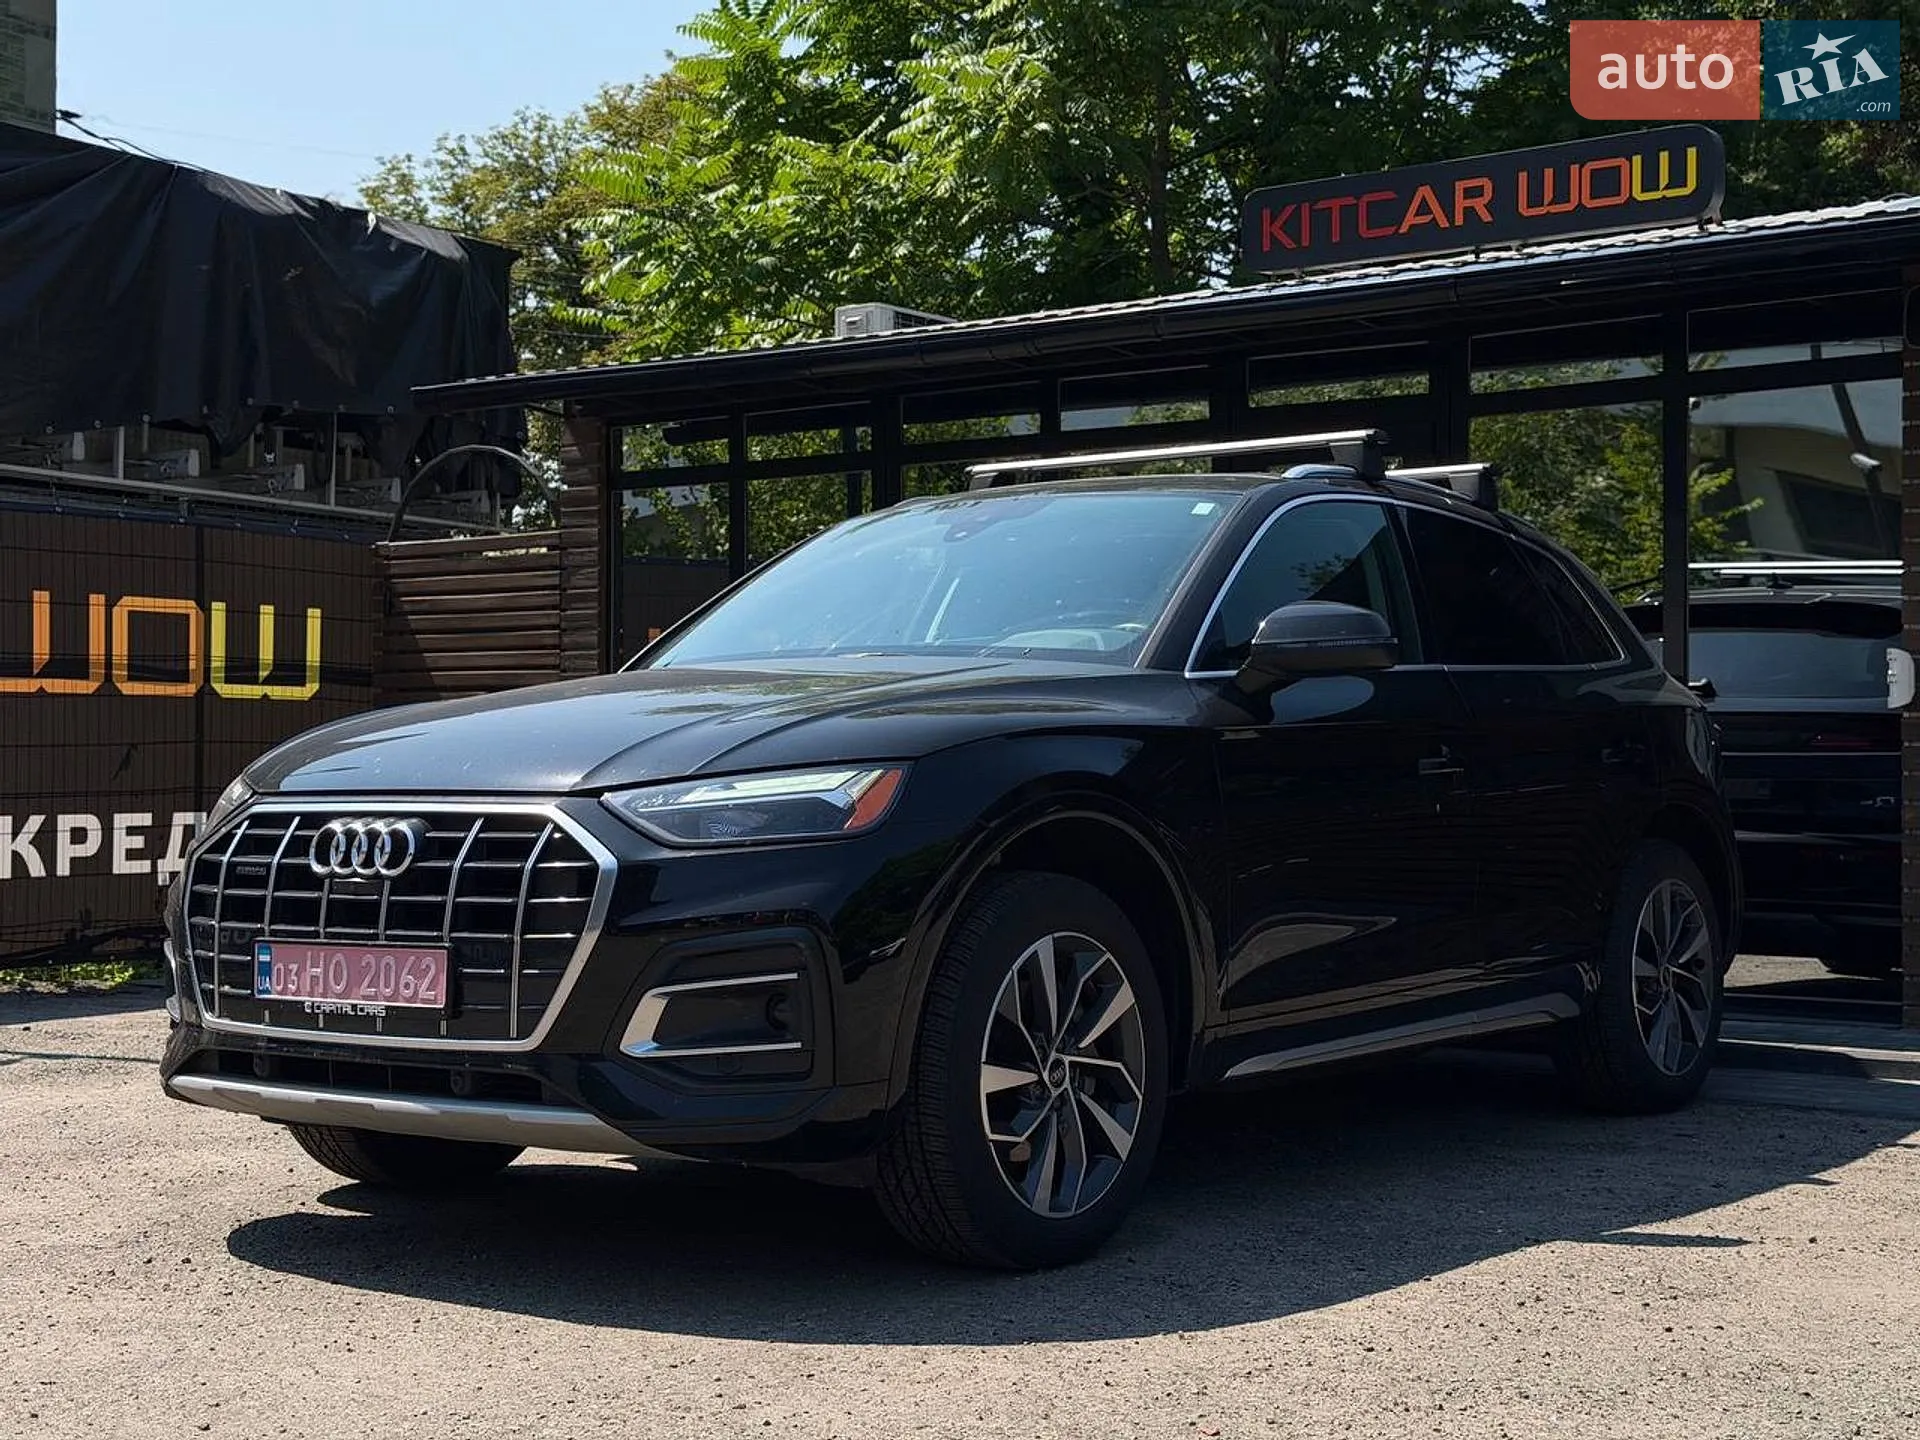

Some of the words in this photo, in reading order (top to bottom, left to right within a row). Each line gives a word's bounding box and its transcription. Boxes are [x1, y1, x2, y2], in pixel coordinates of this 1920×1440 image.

[1261, 176, 1494, 252] KITCAR
[1517, 146, 1698, 217] WOW
[258, 975, 271, 991] UA
[361, 953, 437, 1000] 2062
[314, 1002, 355, 1015] CAPITAL
[357, 1004, 386, 1017] CARS
